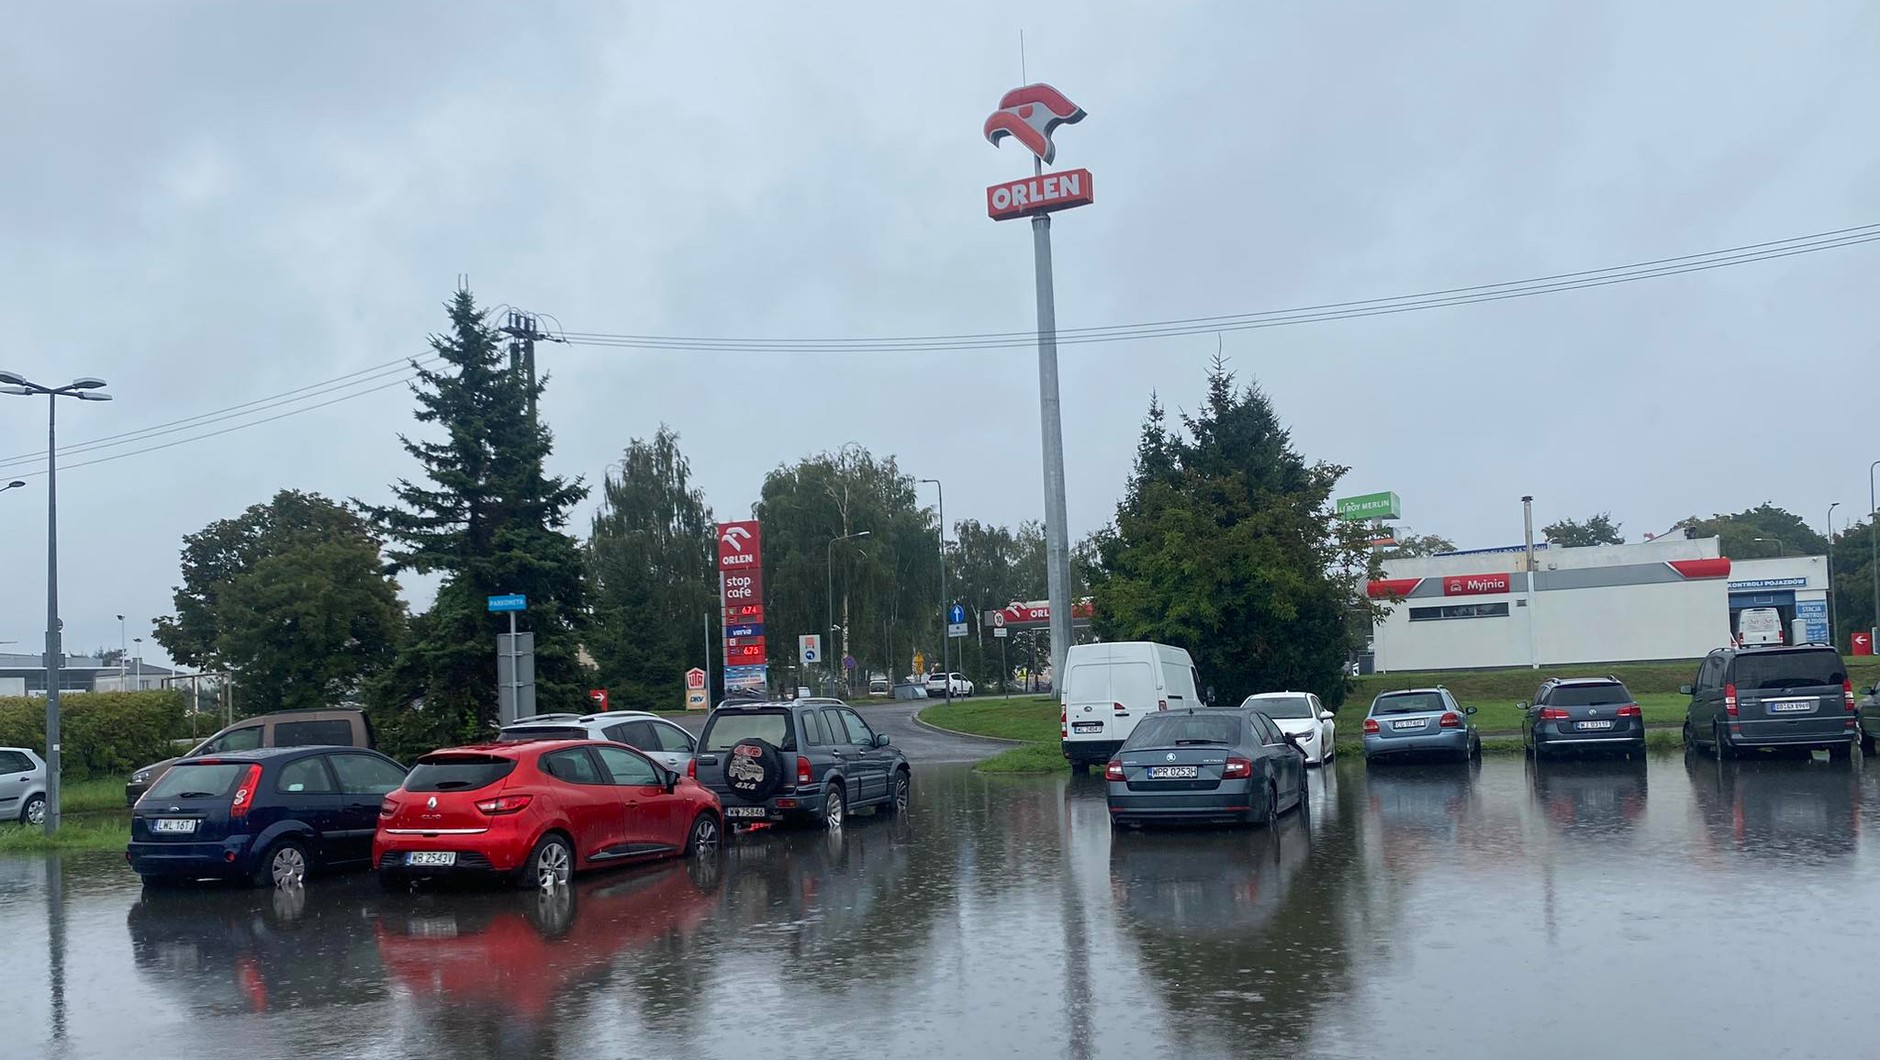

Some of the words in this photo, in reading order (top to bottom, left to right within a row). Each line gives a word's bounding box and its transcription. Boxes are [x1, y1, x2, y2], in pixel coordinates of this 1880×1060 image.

[992, 174, 1080, 210] ORLEN
[1361, 500, 1390, 510] MERLIN
[722, 554, 753, 565] ORLEN
[726, 576, 751, 588] stop
[1467, 579, 1505, 592] Myjnia
[1728, 581, 1764, 589] KONTROLI
[1764, 578, 1805, 587] POJAZDÓW
[727, 587, 752, 599] cafe
[1030, 609, 1050, 618] ORL
[688, 670, 704, 687] UTA
[1153, 767, 1168, 776] WPR
[1170, 767, 1197, 776] 0253H
[735, 782, 756, 790] 4X4
[741, 807, 765, 816] 75846
[159, 820, 173, 830] LWL
[413, 852, 424, 863] WB
[426, 852, 455, 863] 2543V
